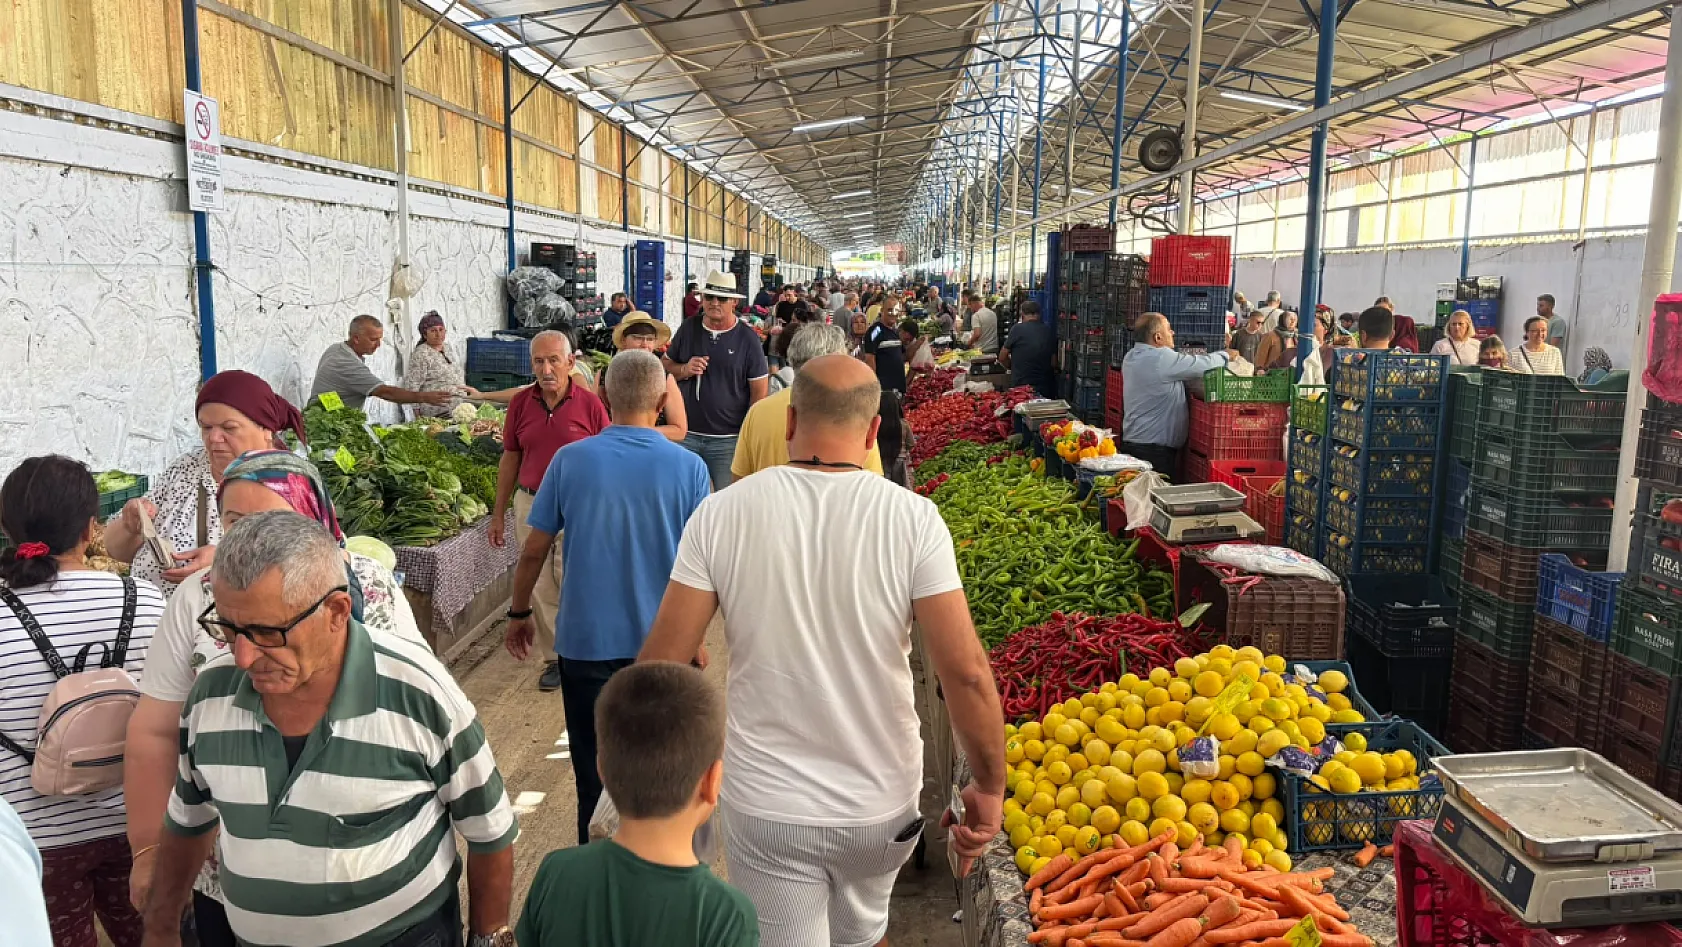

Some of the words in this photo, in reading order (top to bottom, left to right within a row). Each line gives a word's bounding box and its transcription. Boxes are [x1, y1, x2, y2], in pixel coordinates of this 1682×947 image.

[1651, 553, 1682, 573] FIRA
[17, 608, 44, 641] KYLIE
[118, 620, 131, 652] KYLIE
